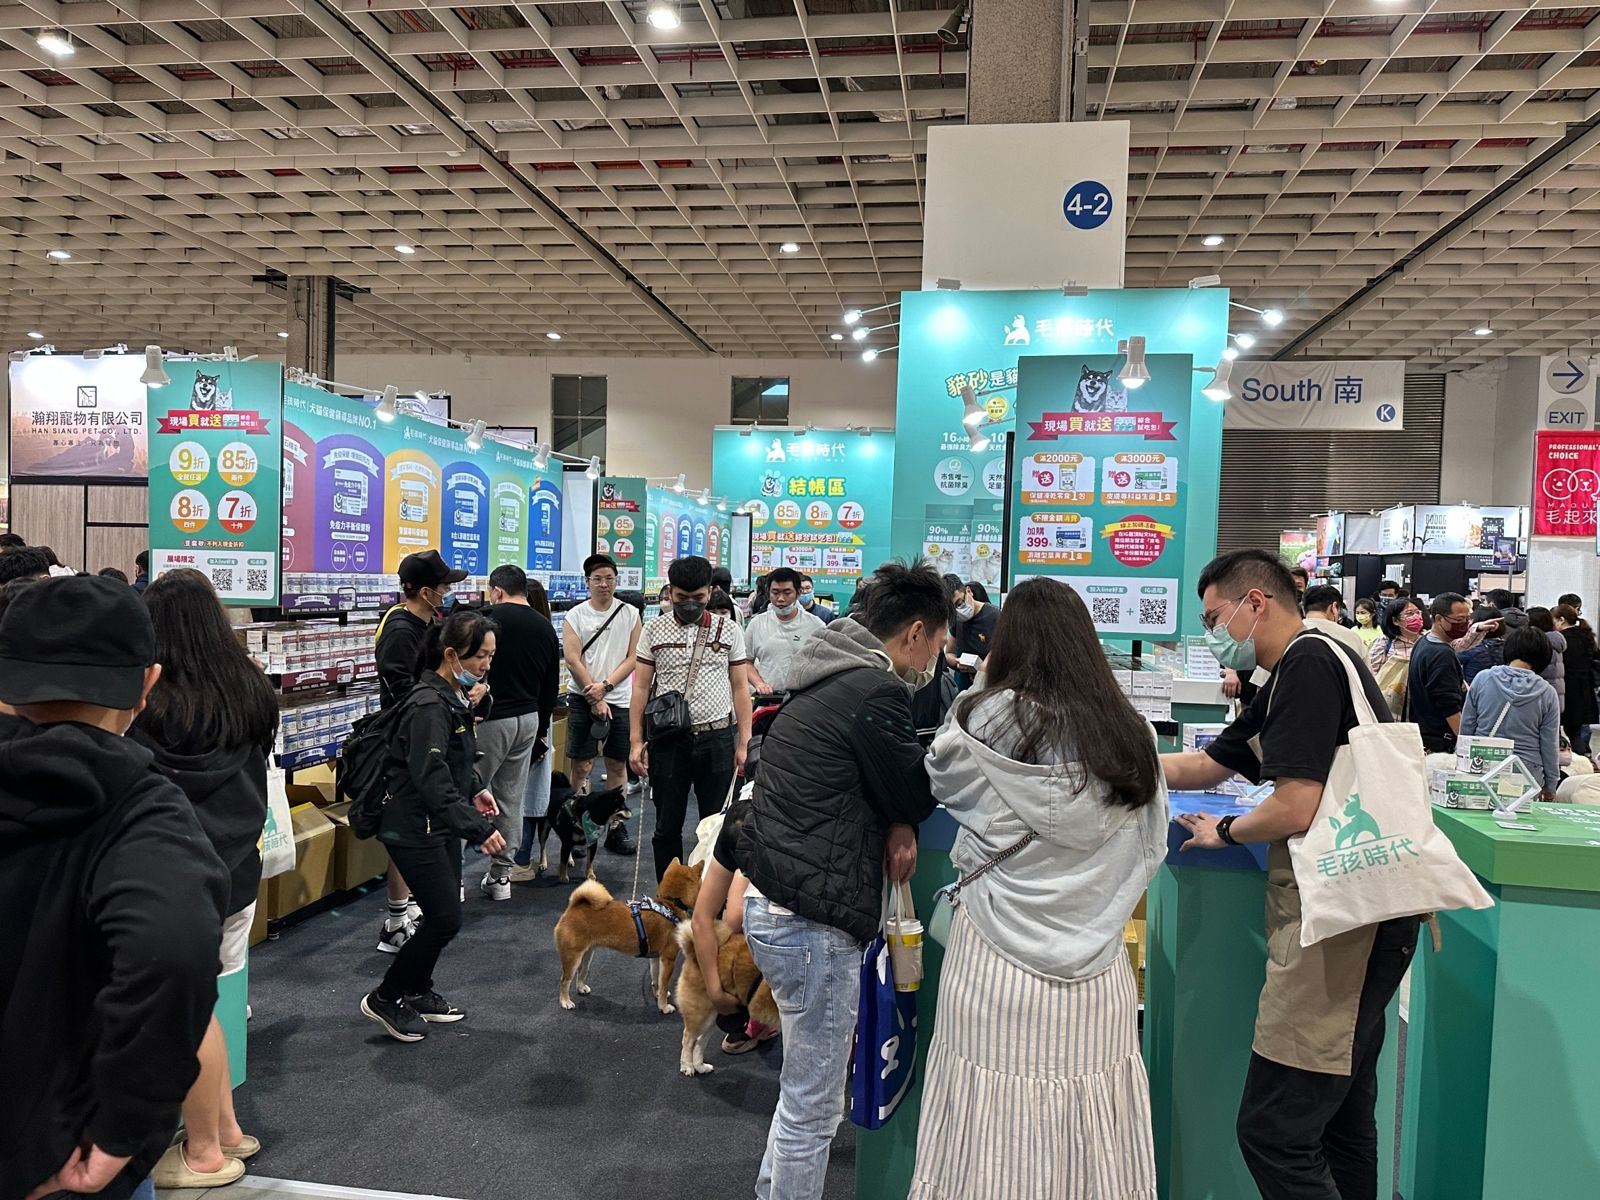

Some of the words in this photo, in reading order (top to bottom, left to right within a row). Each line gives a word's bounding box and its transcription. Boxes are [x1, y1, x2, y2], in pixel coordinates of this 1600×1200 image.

[1067, 193, 1108, 215] 4-2
[1035, 318, 1114, 337] 毛時代
[1242, 378, 1322, 402] South
[1334, 376, 1363, 404] 南
[32, 411, 142, 426] 瀚翔寵物有限公司
[169, 414, 221, 427] 現場買就送
[1380, 406, 1391, 420] K
[1548, 411, 1584, 424] EXIT
[1044, 416, 1112, 432] 現場買就送
[786, 442, 845, 458] 毛時代
[178, 448, 204, 470] 9折
[222, 450, 255, 470] 85折
[1040, 454, 1079, 463] 滿2000元
[1121, 454, 1160, 463] 滿3000元
[788, 477, 846, 497] 結帳區
[178, 496, 204, 518] 8折
[225, 497, 252, 518] 7折
[842, 506, 861, 520] 7折
[977, 524, 1000, 534] 90%
[1316, 838, 1420, 877] 毛孩時代
